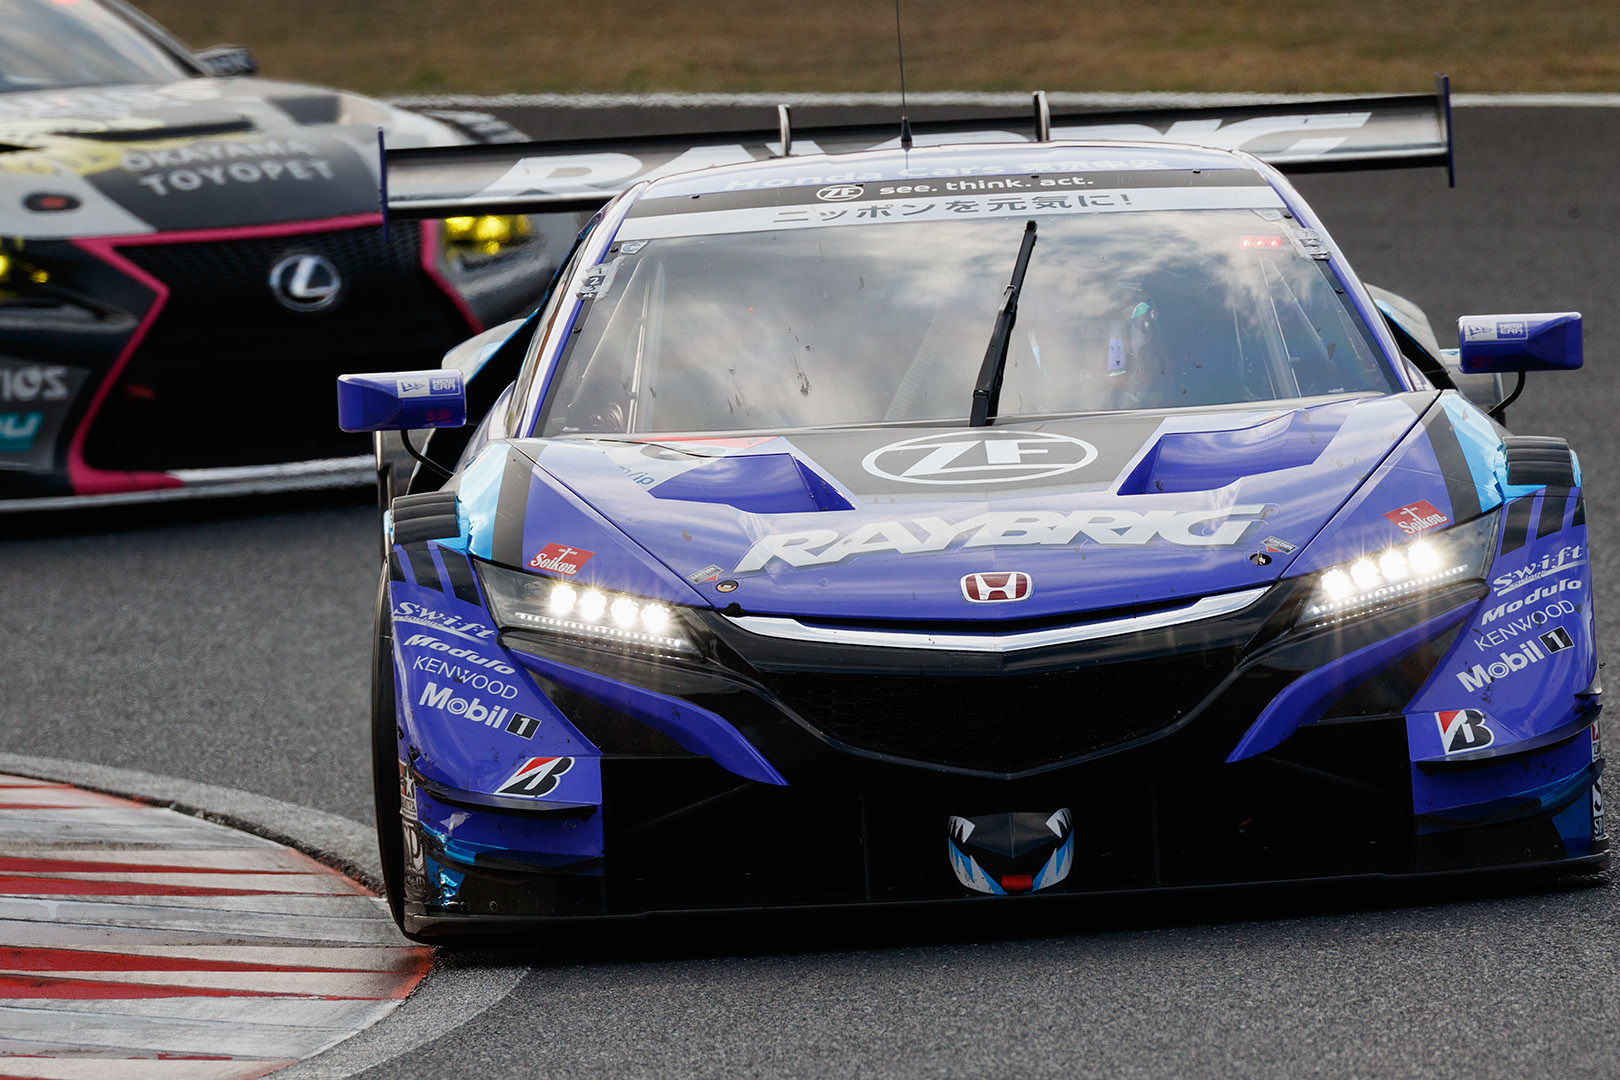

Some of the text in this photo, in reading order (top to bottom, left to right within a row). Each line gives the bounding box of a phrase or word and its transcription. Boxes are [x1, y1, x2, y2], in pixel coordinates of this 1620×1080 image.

[139, 159, 333, 196] TOYOPET
[725, 170, 884, 190] Honda
[898, 164, 1004, 179] Cars
[816, 176, 1094, 202] ZF see. think. act.
[432, 383, 456, 391] ERA
[862, 431, 1098, 484] ZF
[733, 503, 1266, 573] RAYBRIG
[1398, 507, 1447, 533] Seiken
[530, 547, 577, 574] Seiken
[1481, 578, 1582, 626] Modulo
[1474, 600, 1575, 652] KENWOOD
[403, 634, 516, 675] Modulo
[1456, 639, 1545, 692] Mobil
[413, 655, 518, 699] KENWOOD
[419, 681, 509, 729] Mobil
